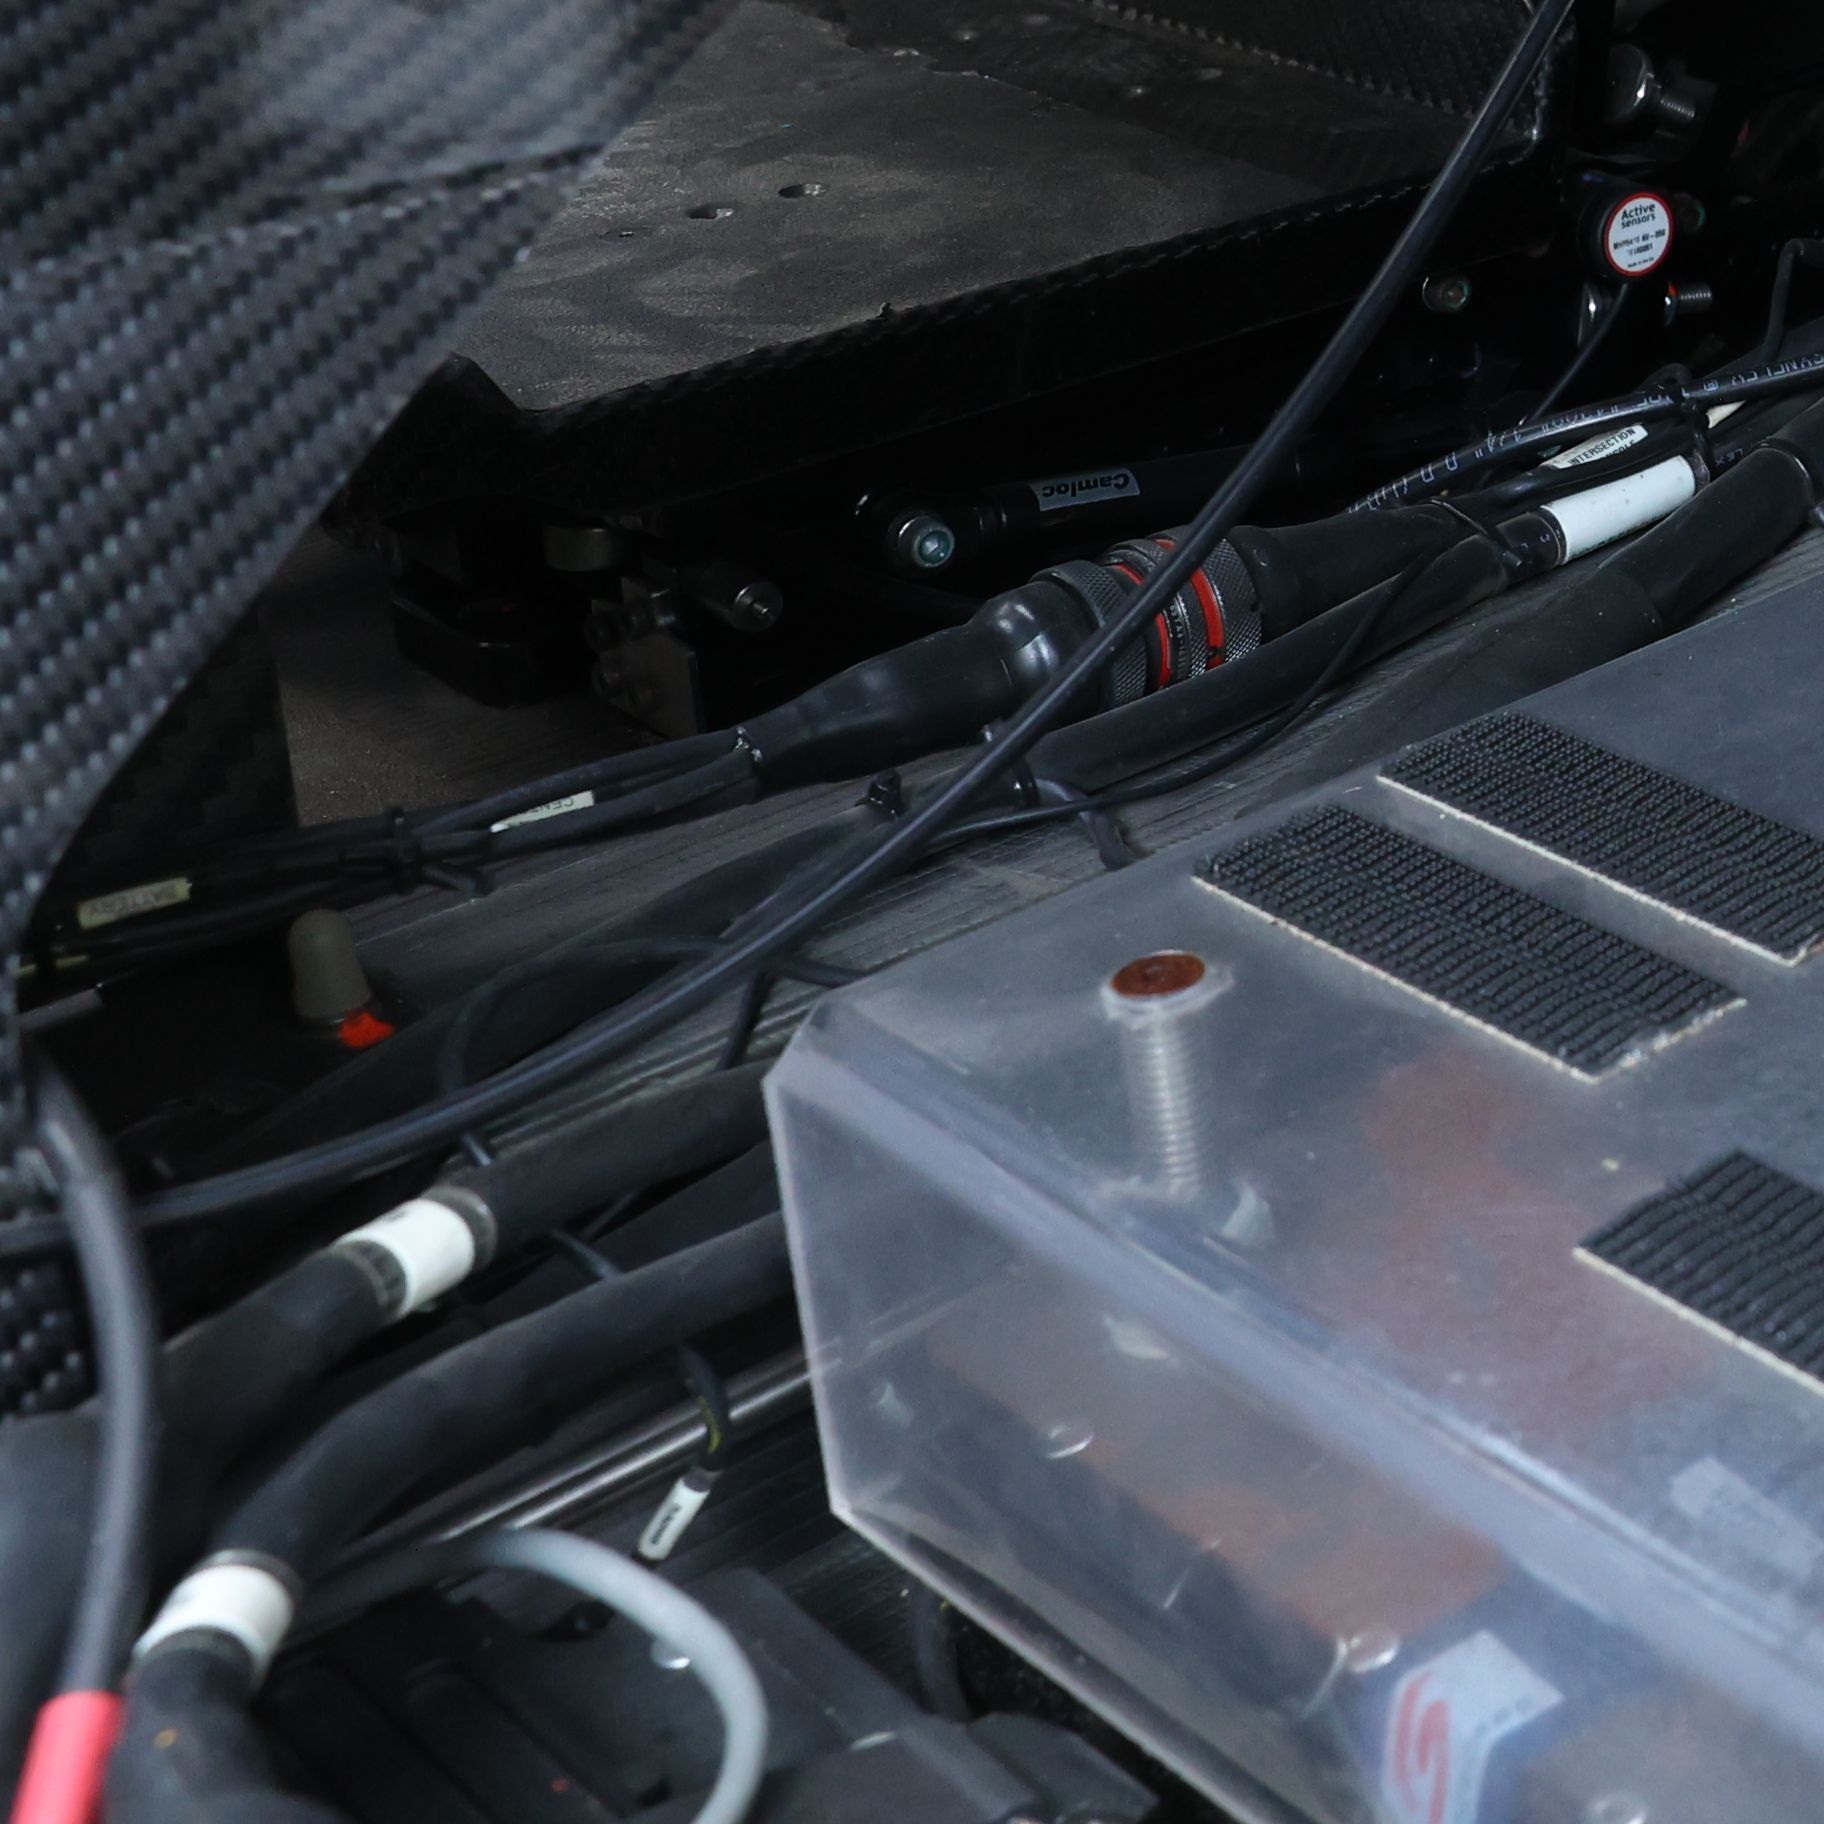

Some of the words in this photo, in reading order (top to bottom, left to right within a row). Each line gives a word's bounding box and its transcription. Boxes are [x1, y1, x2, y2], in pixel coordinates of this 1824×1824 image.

[1621, 204, 1656, 221] Active
[1621, 213, 1656, 230] sensors
[1568, 427, 1637, 465] INTERSECTION
[1042, 474, 1130, 497] Camloc
